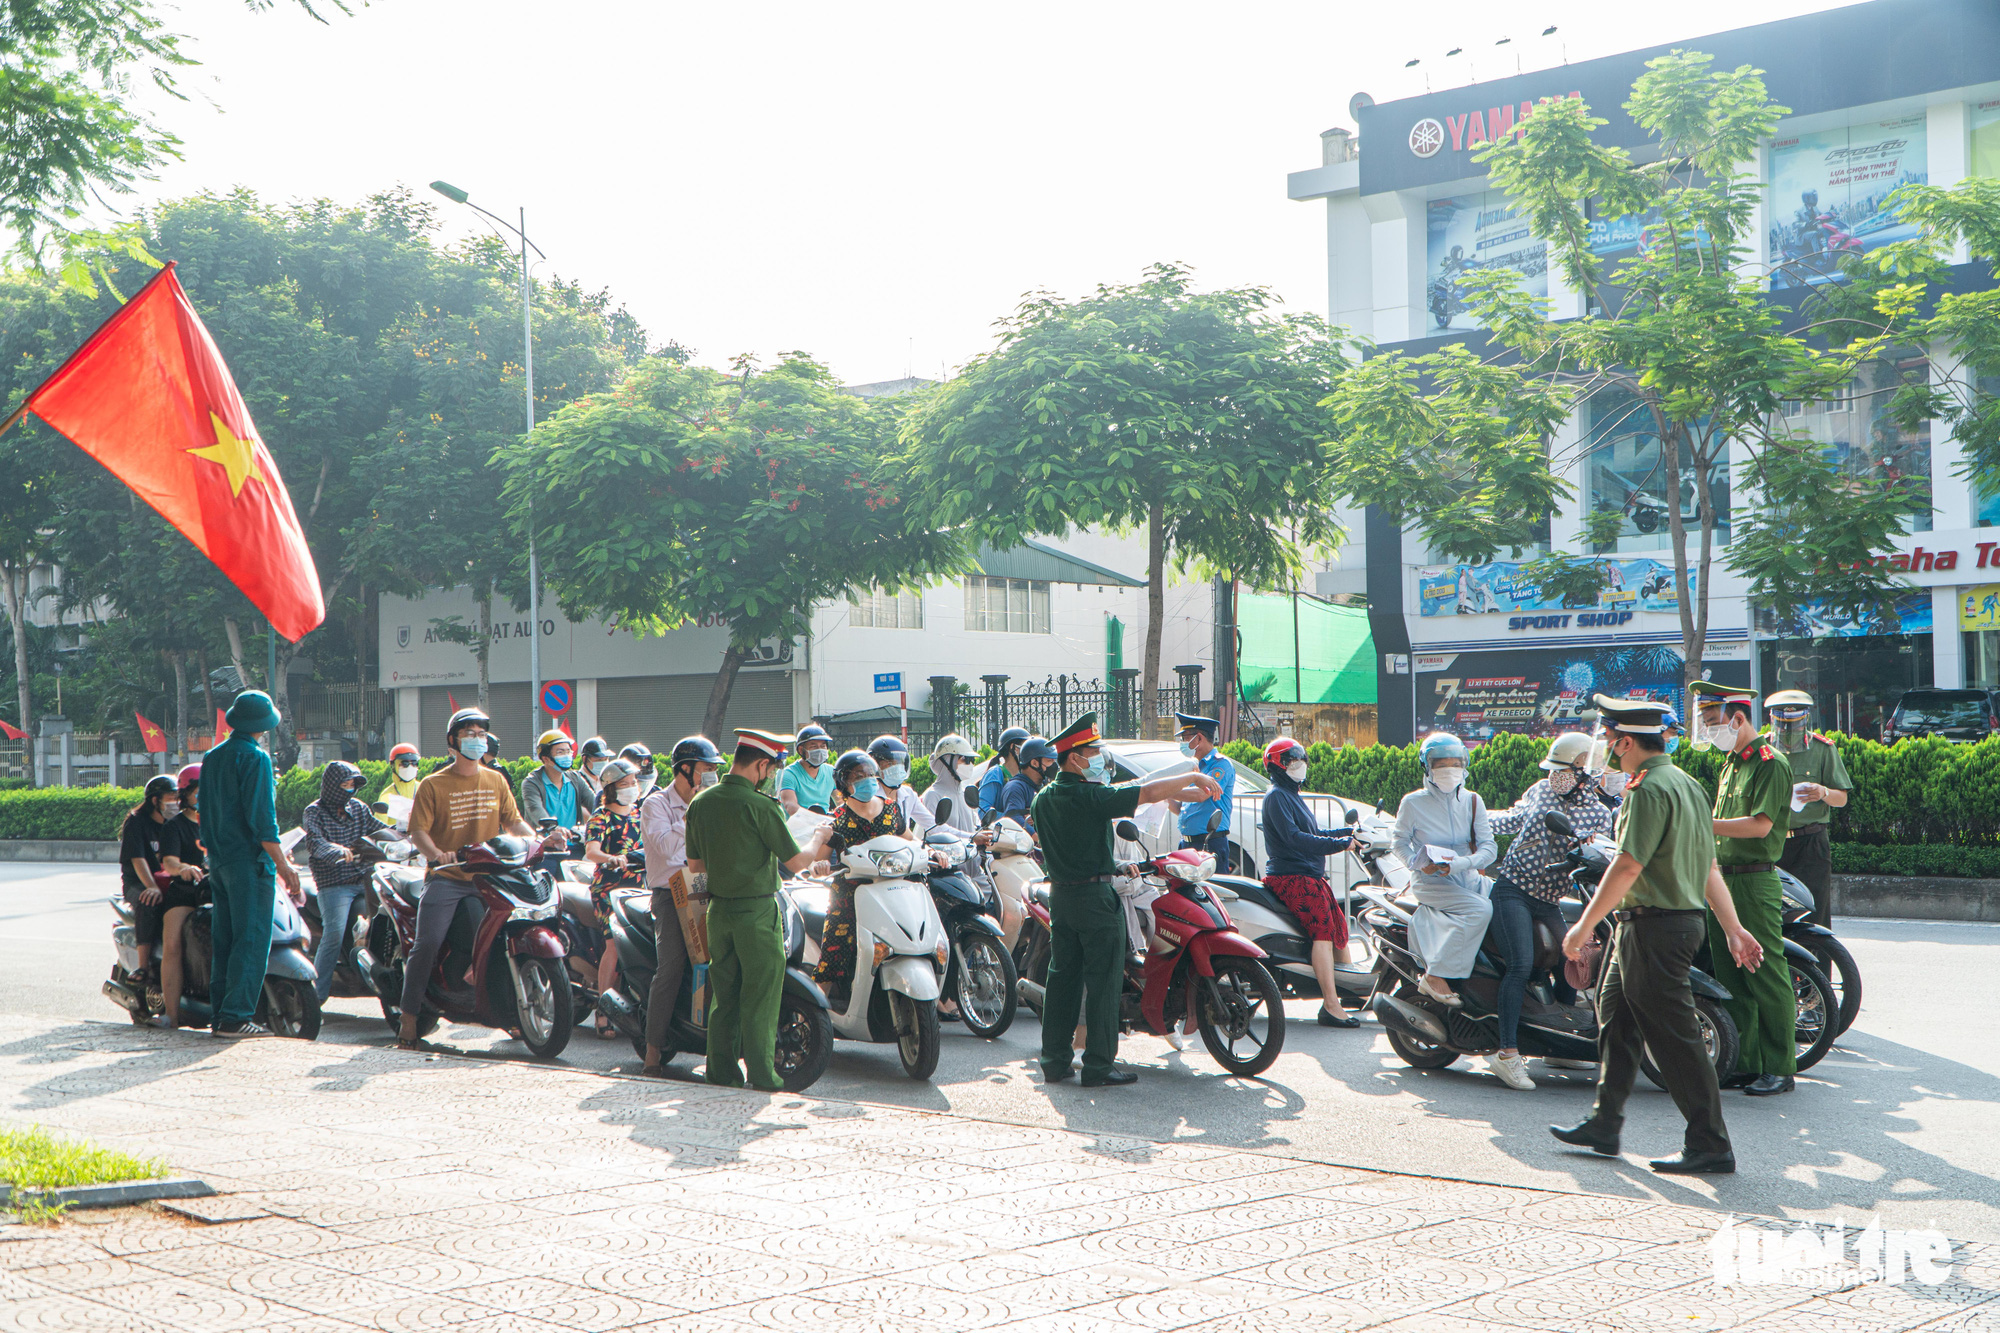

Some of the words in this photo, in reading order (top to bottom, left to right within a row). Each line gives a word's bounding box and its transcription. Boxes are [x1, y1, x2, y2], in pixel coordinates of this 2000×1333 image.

[1446, 91, 1584, 151] YAMA
[1777, 138, 1799, 147] YAMAHA
[1847, 165, 1868, 174] CHỌN
[1870, 162, 1887, 170] TINH
[1508, 614, 1572, 630] SPORT
[1577, 612, 1633, 627] SHOP
[487, 622, 510, 644] ẠT
[513, 619, 555, 637] AUO
[1435, 678, 1460, 716] 7
[1487, 709, 1497, 717] XE
[1499, 709, 1531, 717] FREEGO
[1160, 927, 1181, 944] YAMAHA
